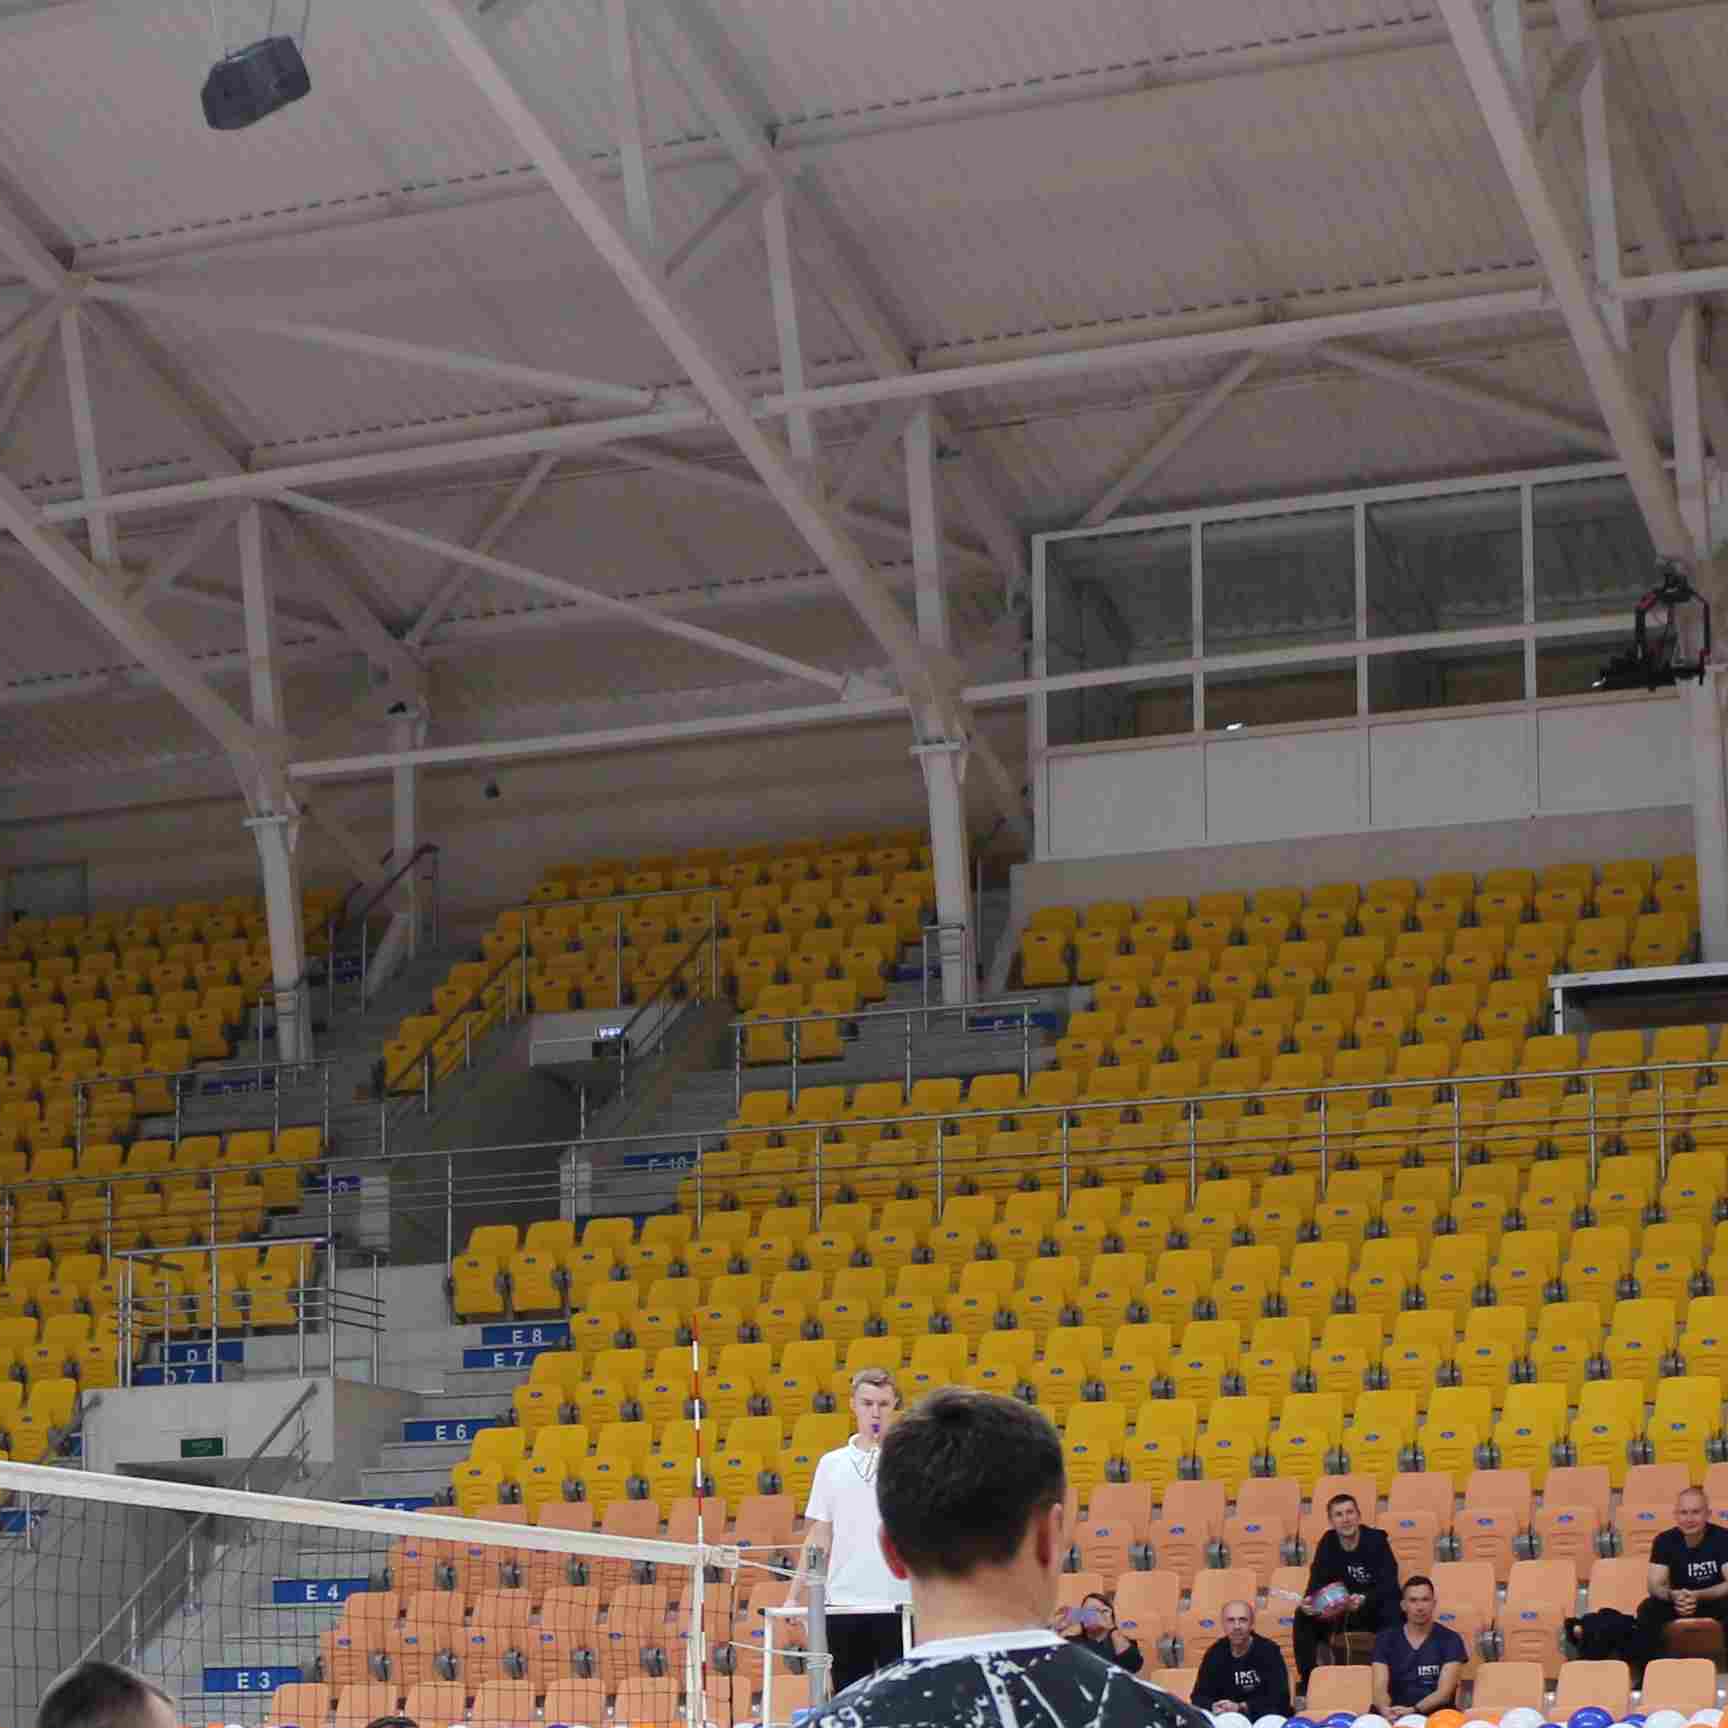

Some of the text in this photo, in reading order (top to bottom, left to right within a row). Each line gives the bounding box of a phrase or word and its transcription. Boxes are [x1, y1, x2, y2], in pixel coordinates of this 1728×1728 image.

[512, 1329, 543, 1345] E 8
[493, 1352, 524, 1368] E 7
[185, 1368, 195, 1384] 7
[436, 1423, 467, 1441] E 6
[306, 1583, 339, 1601] E 4
[237, 1672, 271, 1689] E 3
